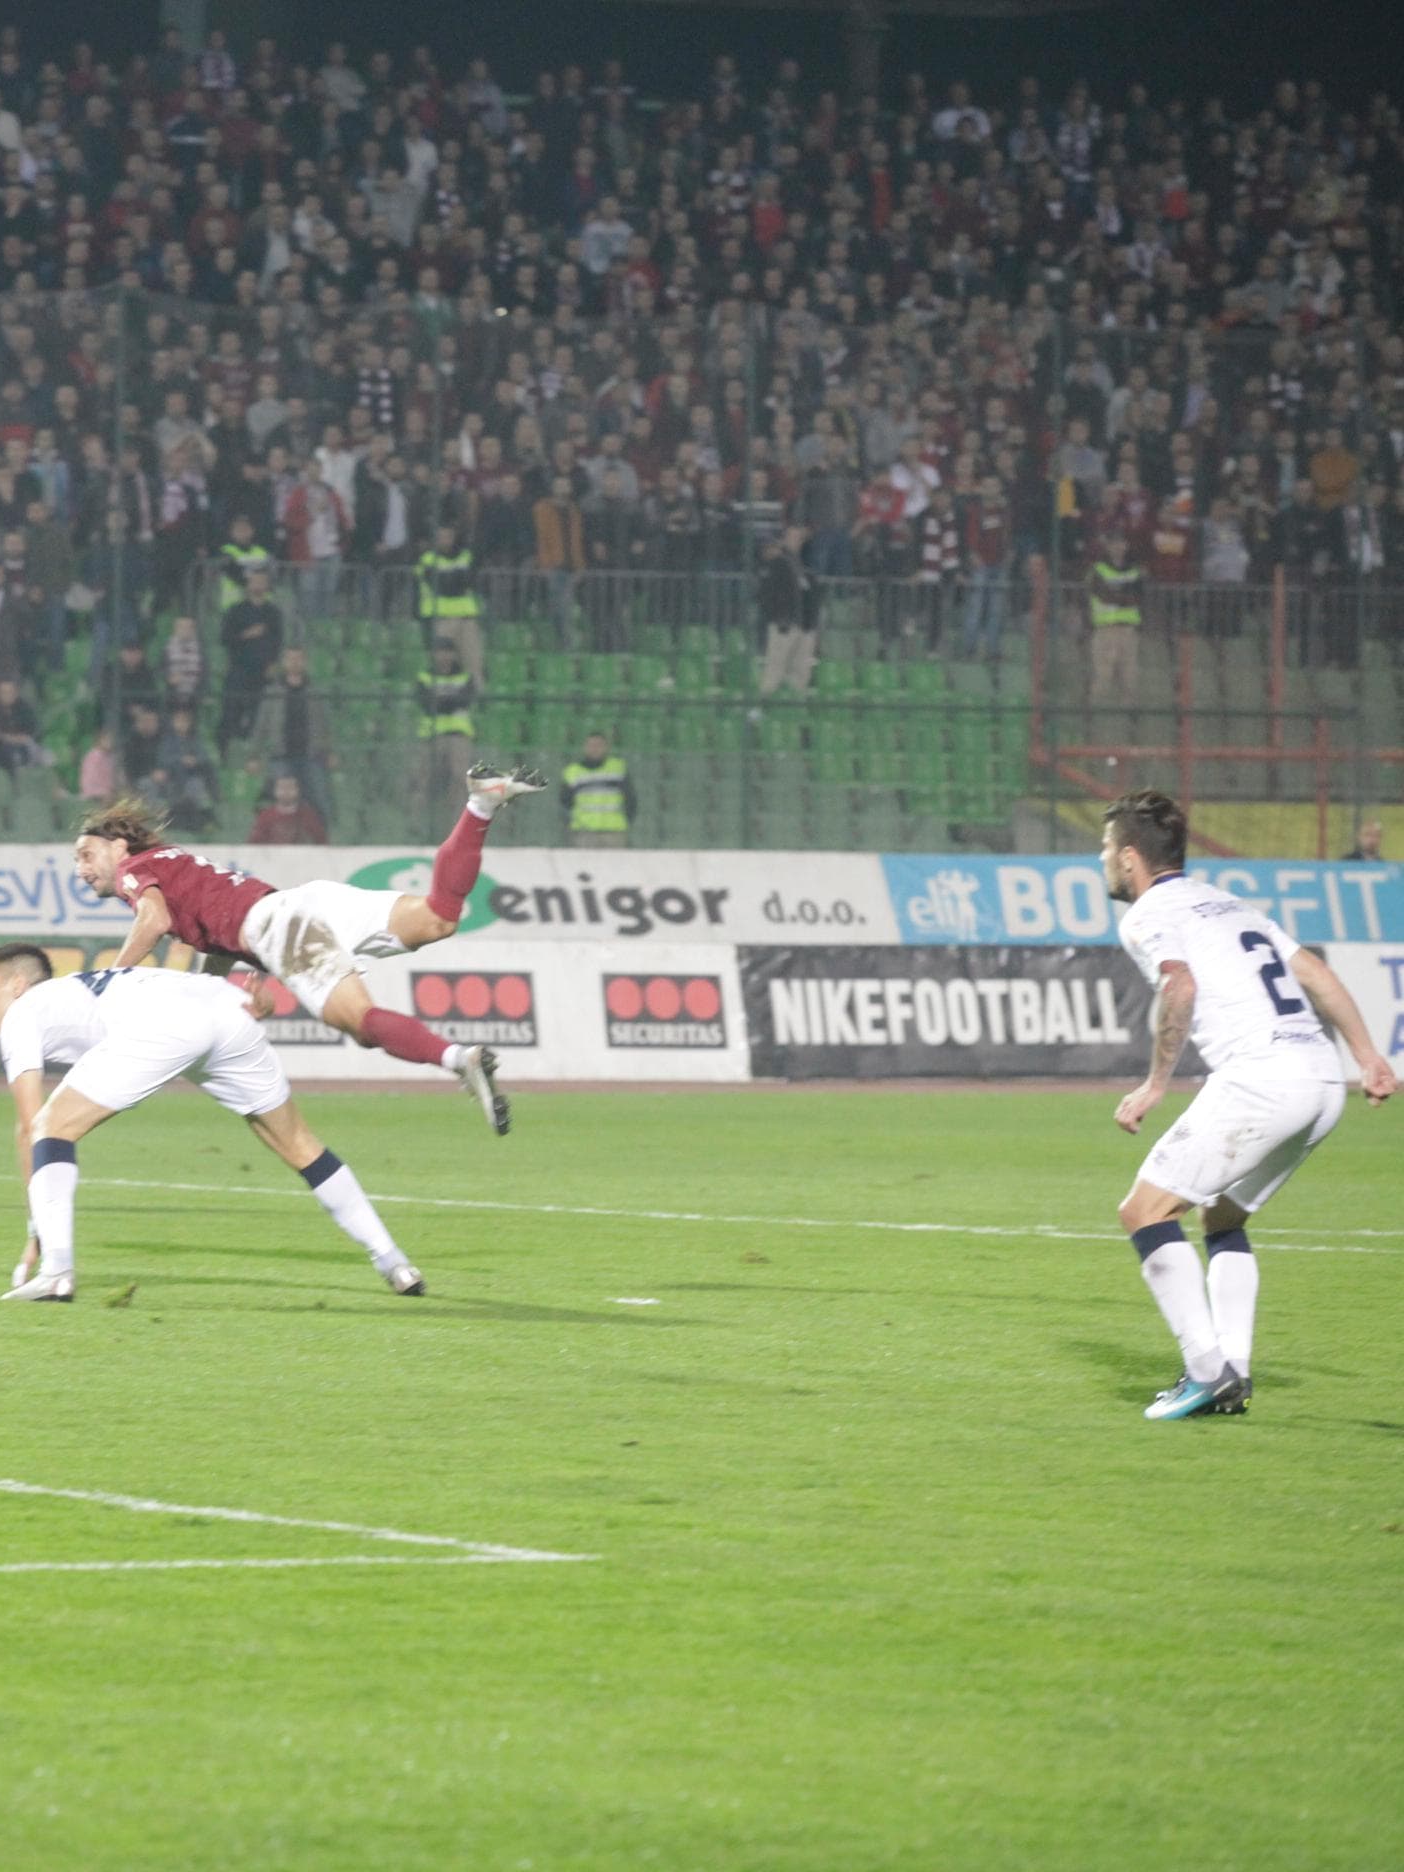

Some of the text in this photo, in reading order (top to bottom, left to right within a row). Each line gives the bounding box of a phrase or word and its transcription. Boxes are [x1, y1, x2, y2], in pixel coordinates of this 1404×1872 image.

[488, 871, 867, 936] enigor d.o.o.
[1239, 929, 1306, 1017] 2
[427, 1021, 536, 1044] CURITAS
[609, 1022, 726, 1046] SECURITAS
[768, 976, 1131, 1047] NIKEFOOTBALL
